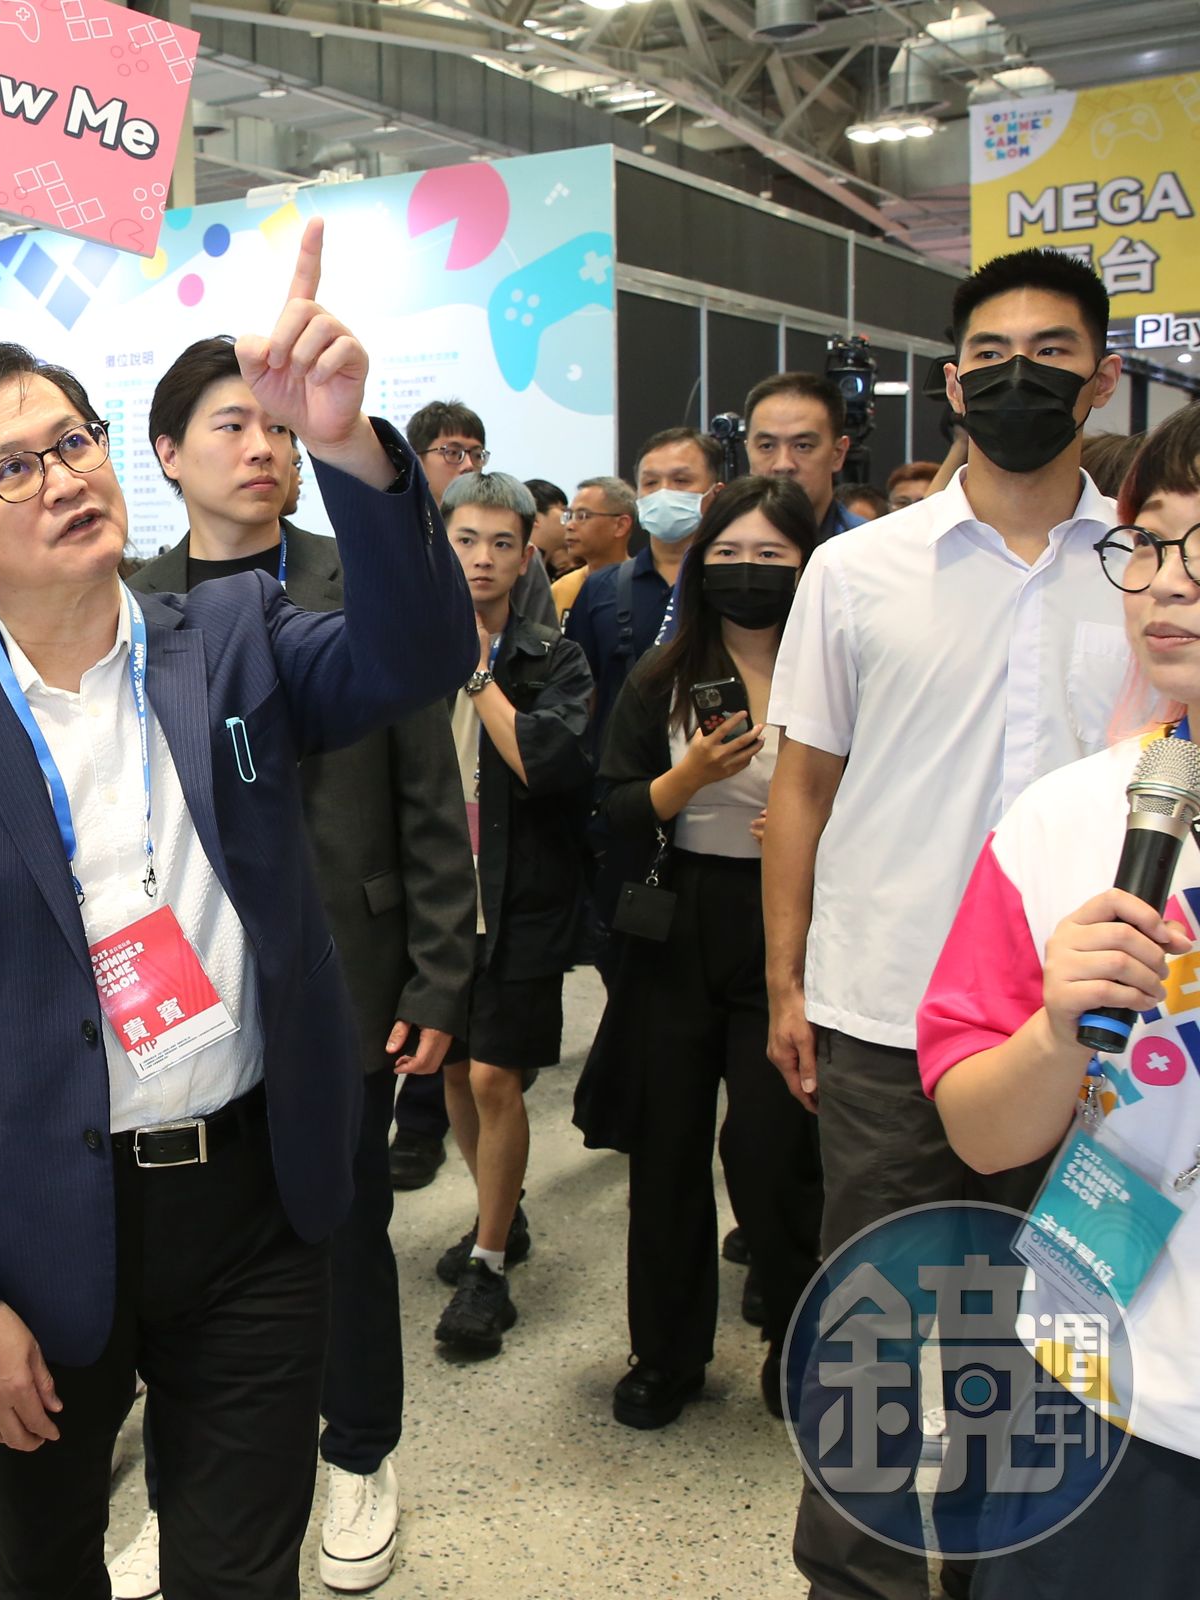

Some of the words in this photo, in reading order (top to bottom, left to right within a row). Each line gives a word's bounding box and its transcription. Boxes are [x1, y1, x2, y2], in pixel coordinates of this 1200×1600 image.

[64, 85, 159, 160] Me
[1007, 172, 1193, 237] MEGA
[90, 949, 109, 963] 023
[92, 941, 145, 976] SUMMER
[96, 961, 135, 986] GAME
[133, 1039, 158, 1056] VIP
[1072, 1151, 1131, 1203] SUMMER
[1030, 1230, 1104, 1299] ORGANIZER
